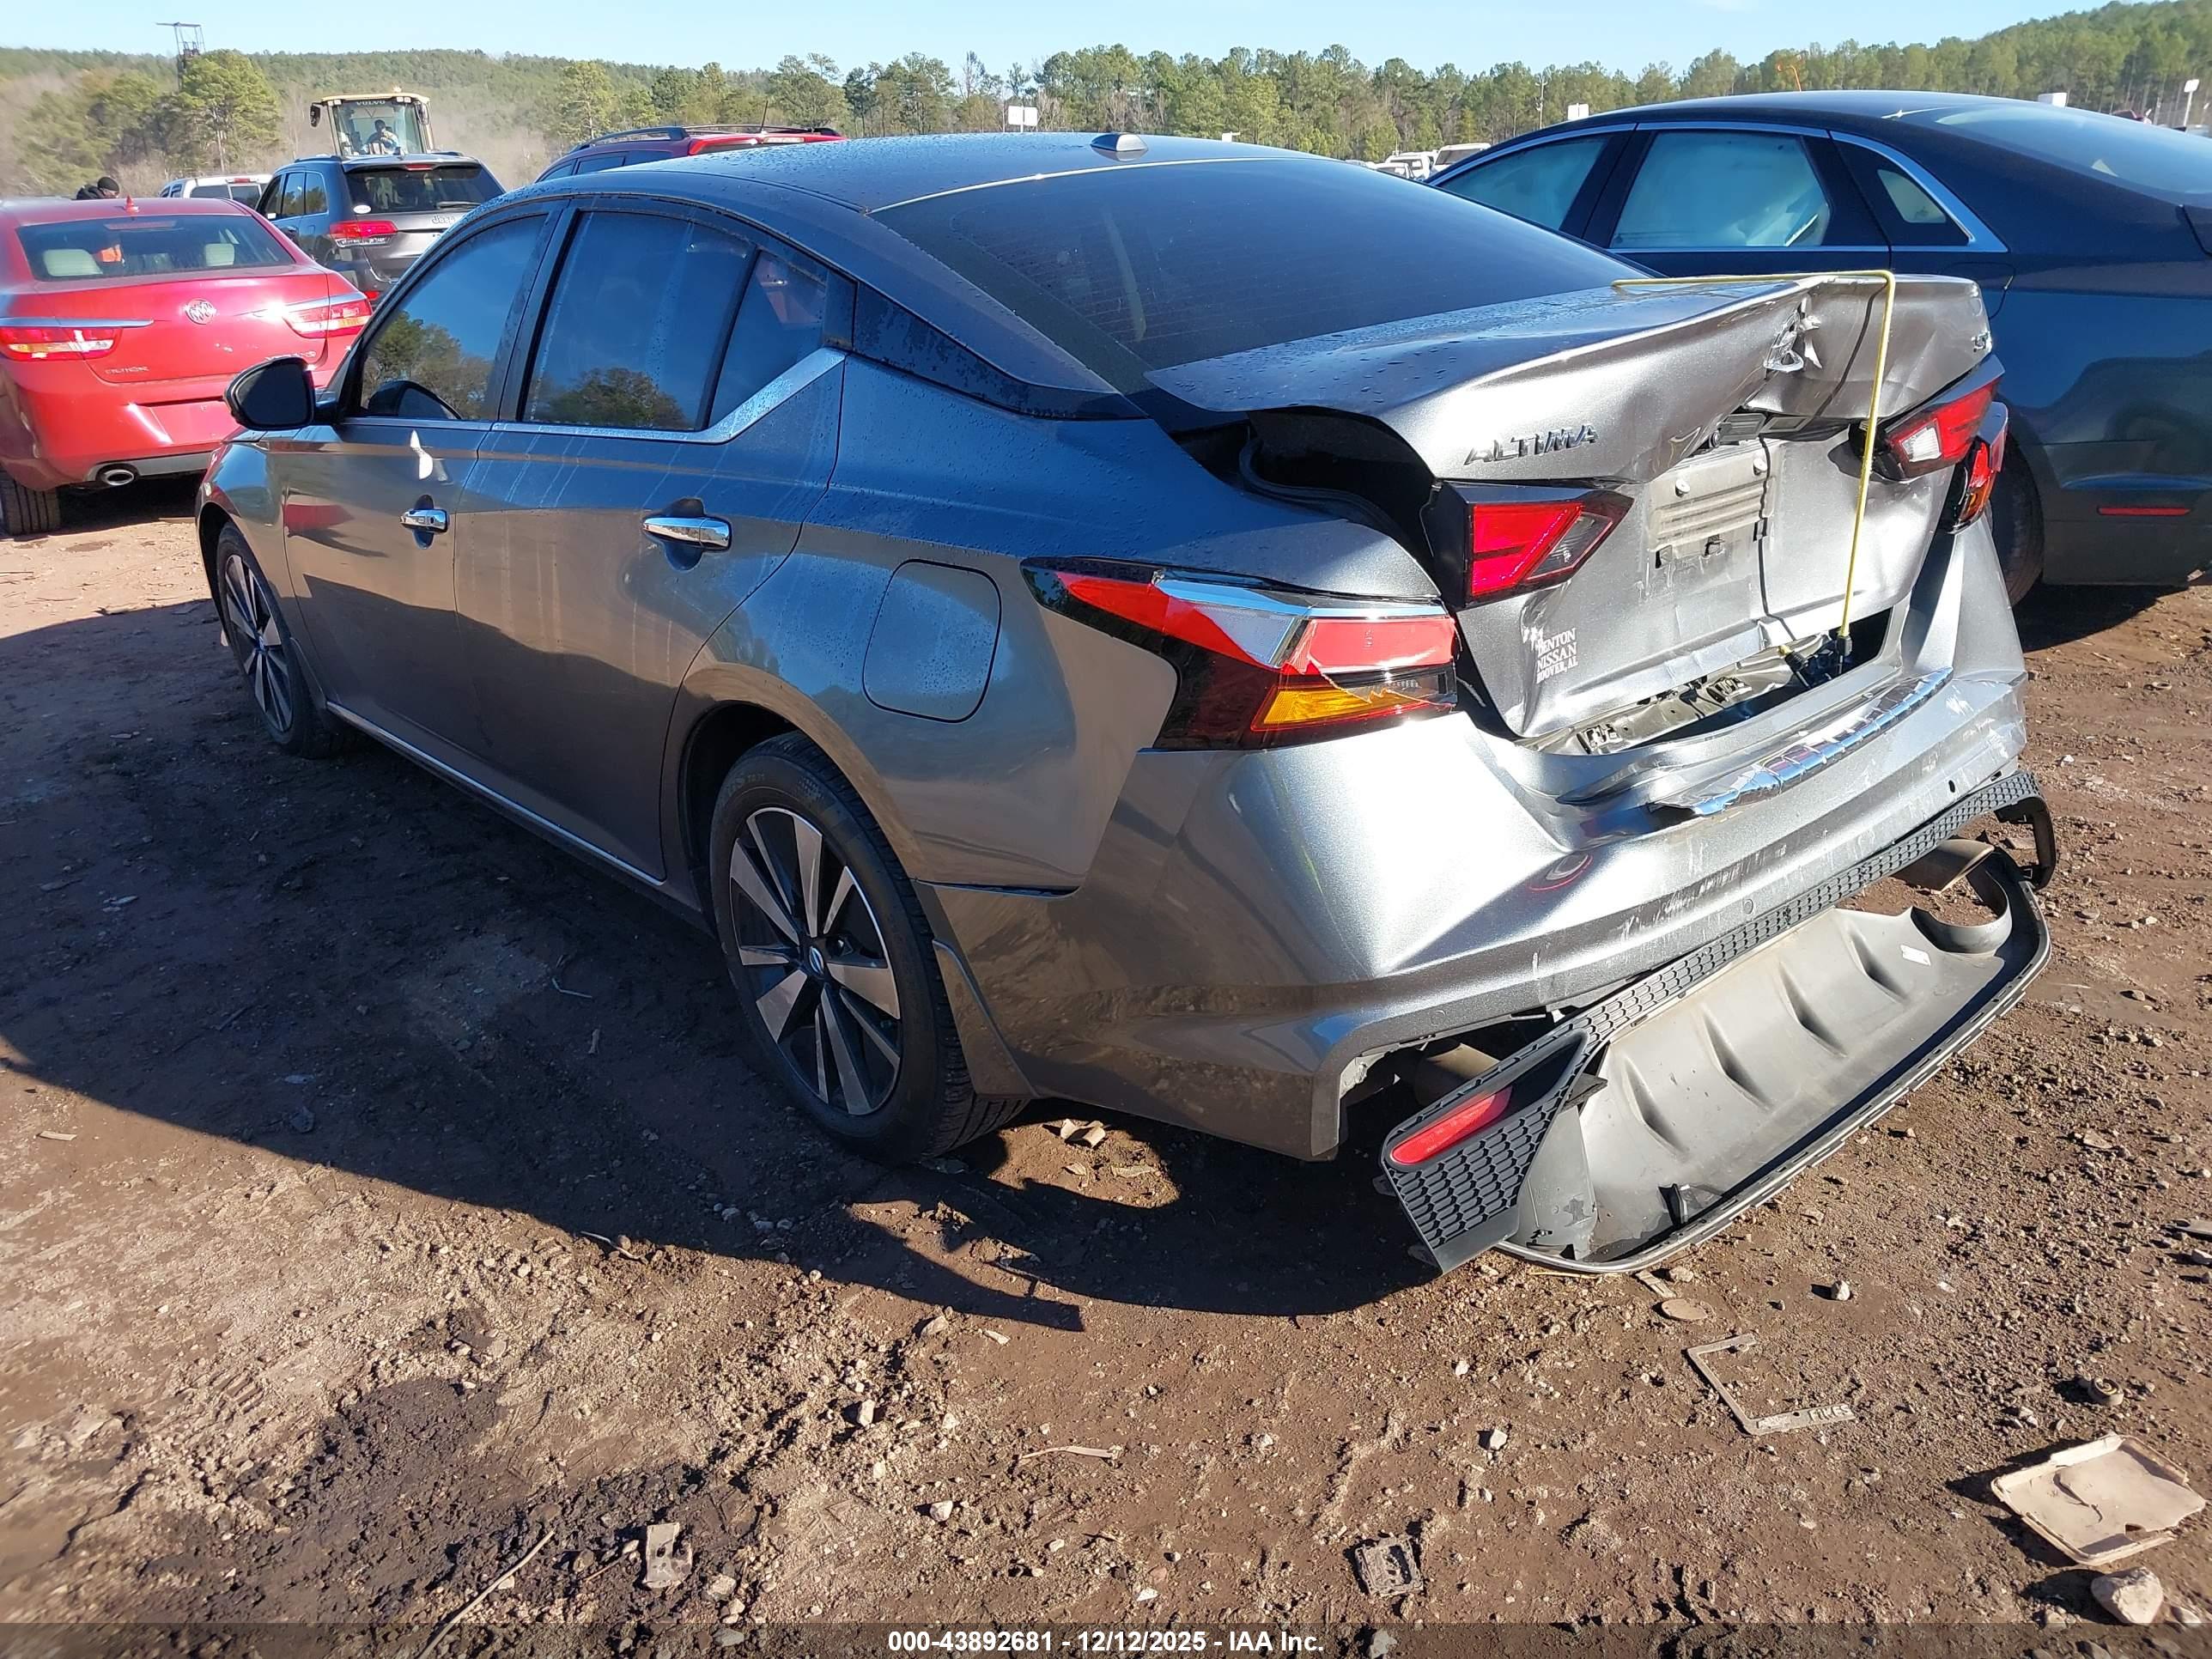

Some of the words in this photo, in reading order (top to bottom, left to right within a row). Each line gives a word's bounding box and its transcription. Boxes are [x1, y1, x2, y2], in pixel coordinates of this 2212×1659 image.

[432, 215, 456, 224] Jeep
[1462, 423, 1599, 465] ALTIMA
[1536, 642, 1577, 673] NISSAN
[1568, 655, 1579, 669] AL
